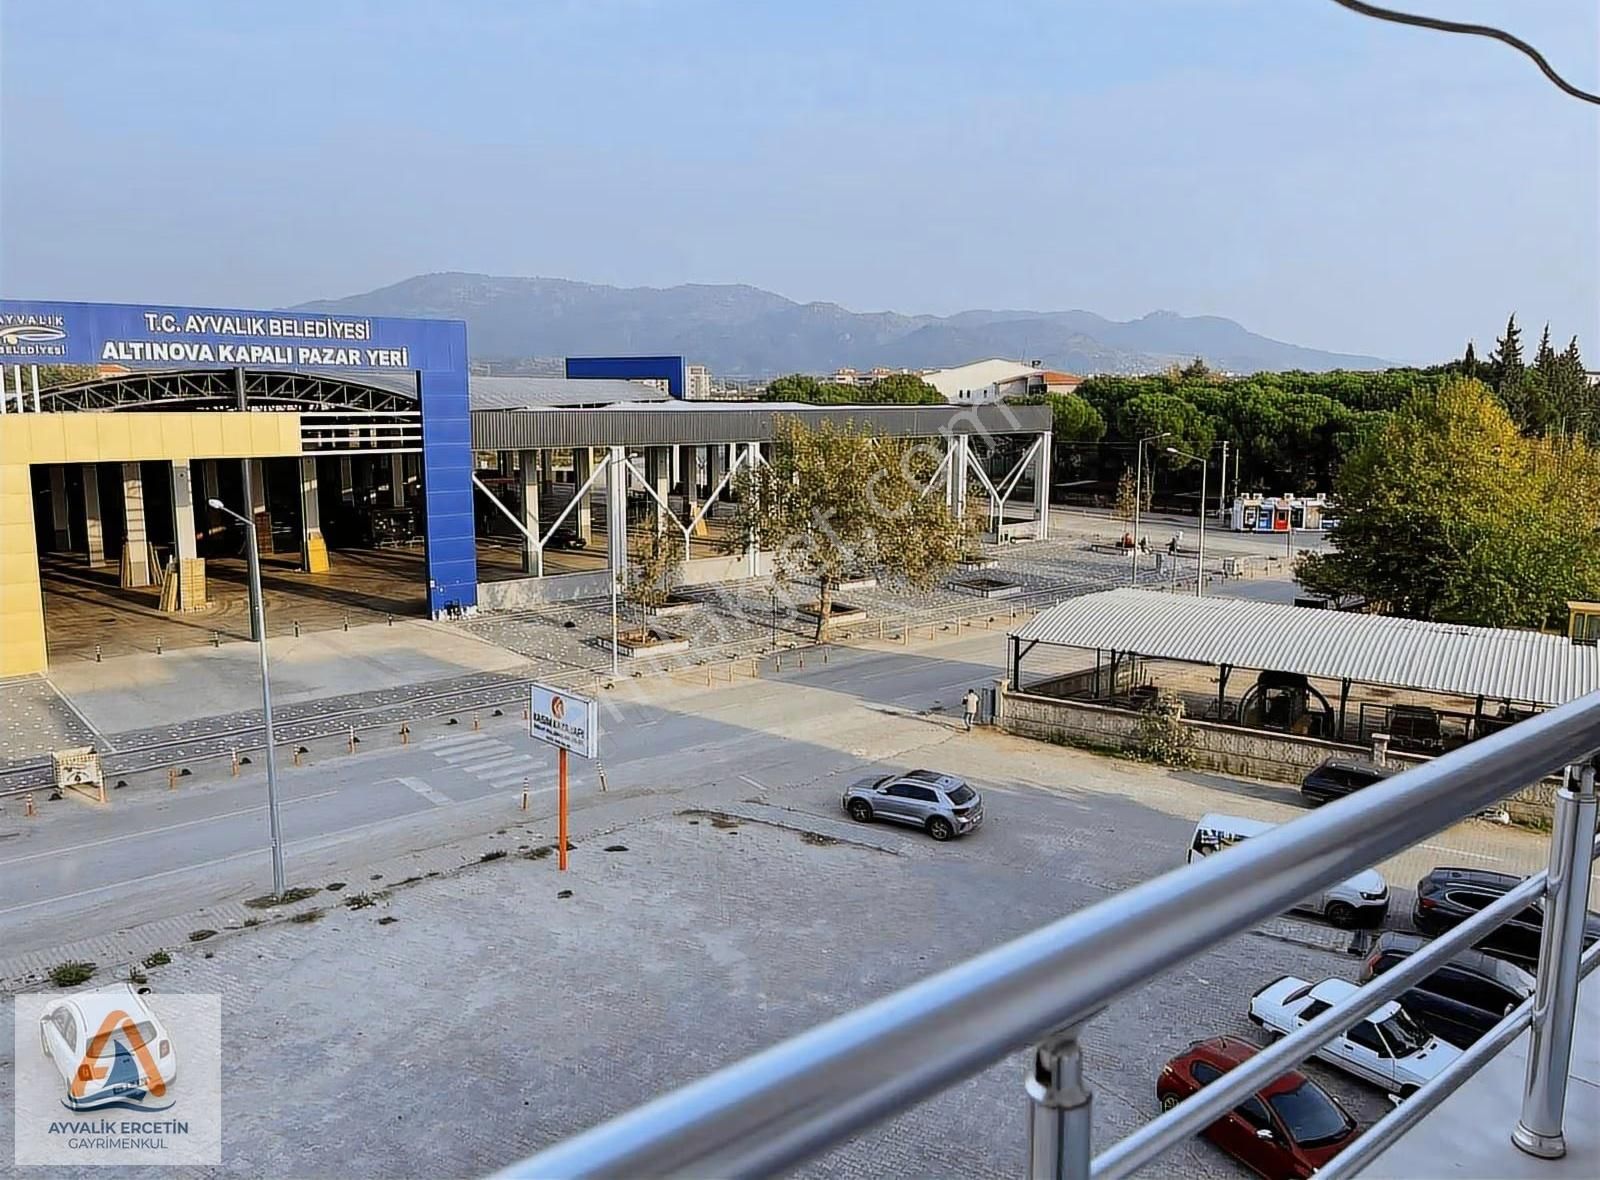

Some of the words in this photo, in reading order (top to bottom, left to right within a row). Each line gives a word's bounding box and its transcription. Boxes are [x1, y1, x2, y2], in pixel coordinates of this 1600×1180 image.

[144, 313, 181, 333] T.C.
[185, 315, 265, 336] AYVALIK
[269, 318, 370, 339] BELEDİYESİ
[102, 341, 214, 362] ALTINOVA
[218, 344, 293, 364] KAPALI
[298, 347, 362, 365] PAZAR
[366, 346, 408, 367] YERİ
